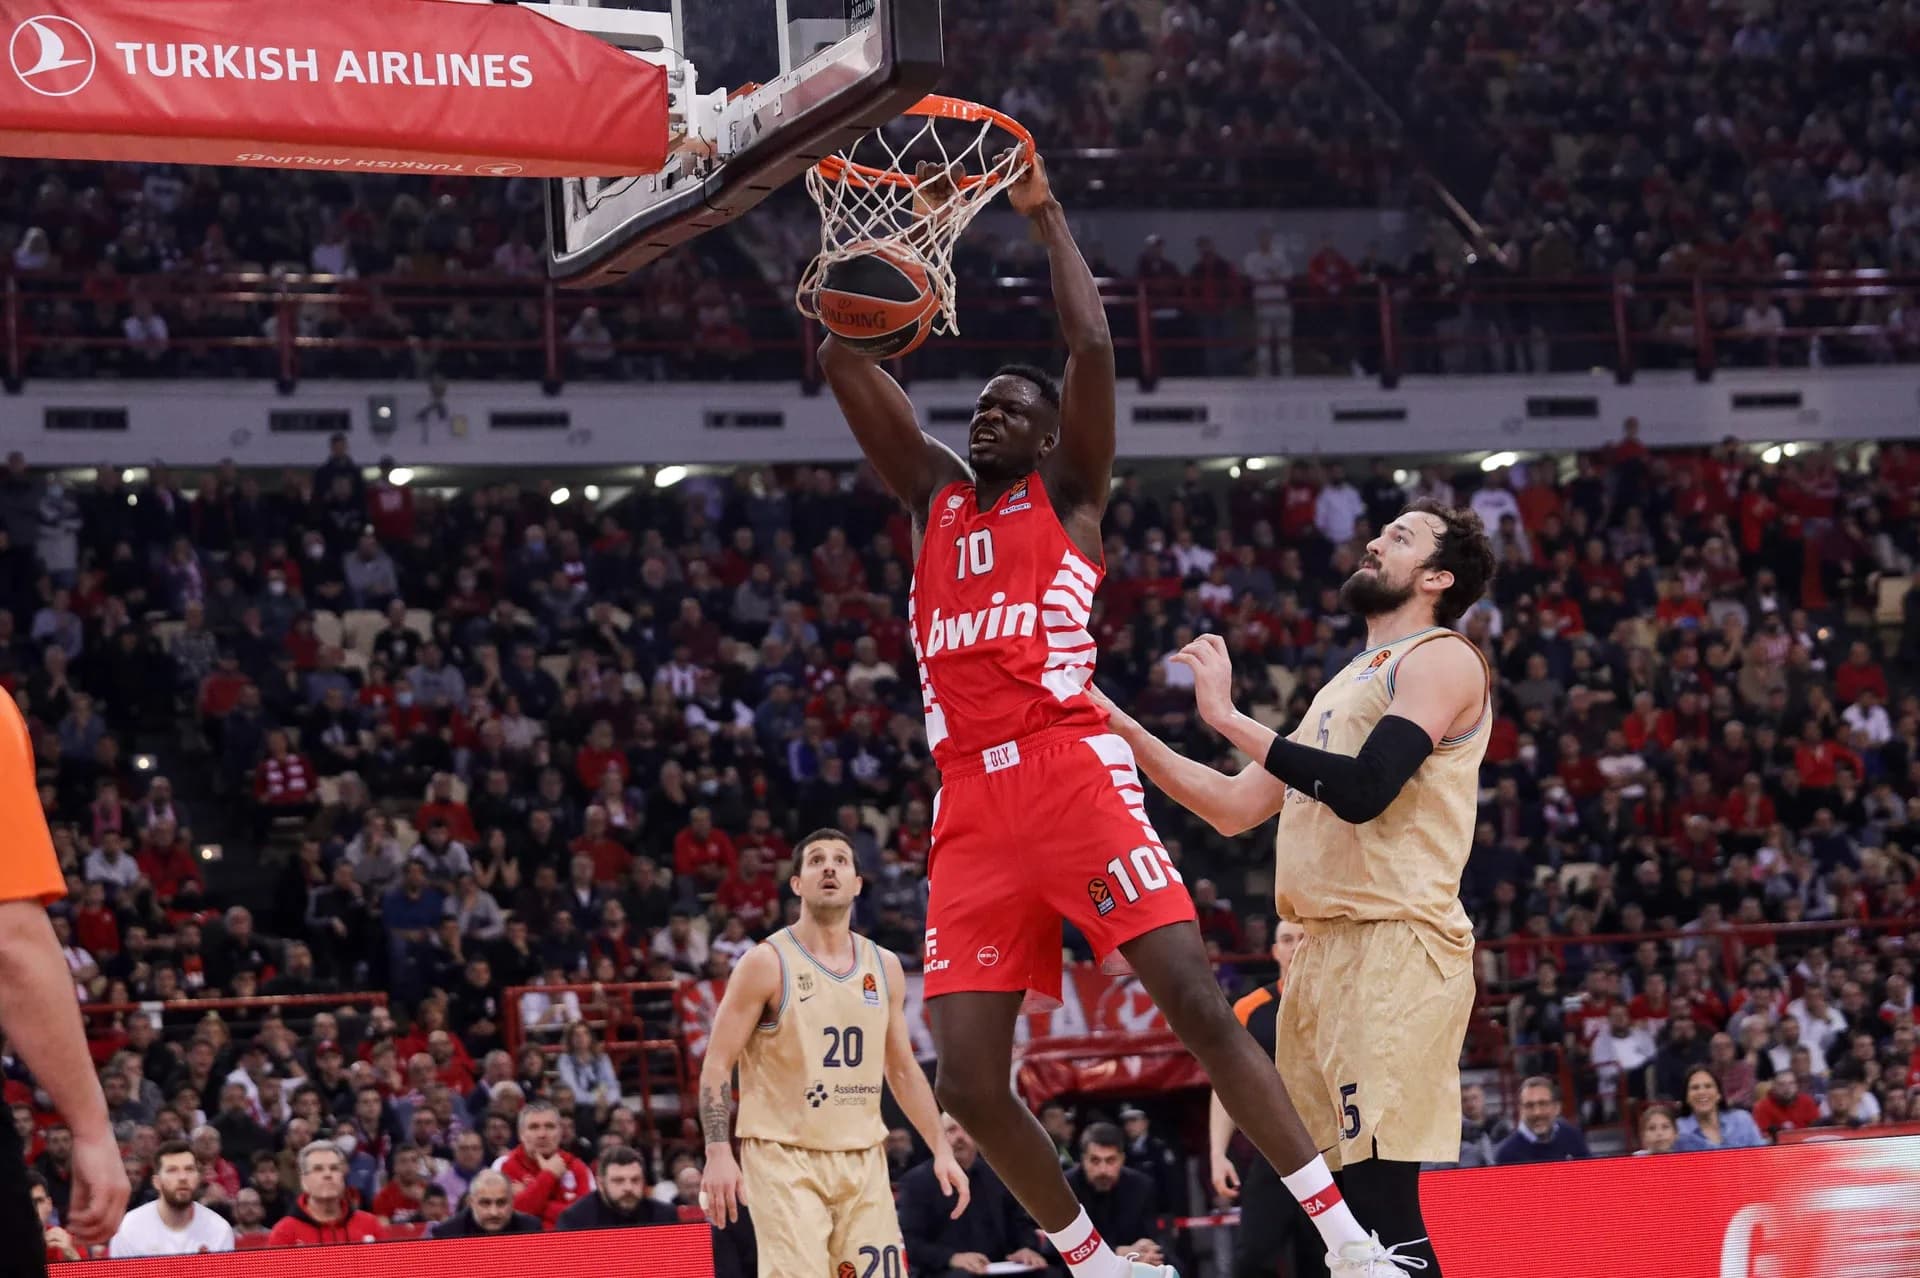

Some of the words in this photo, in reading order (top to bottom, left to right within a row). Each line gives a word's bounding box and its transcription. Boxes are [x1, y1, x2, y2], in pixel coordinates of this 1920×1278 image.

[115, 42, 318, 82] TURKISH
[334, 48, 533, 88] AIRLINES
[235, 153, 351, 166] AIRLINES
[355, 160, 464, 172] TURKISH
[954, 527, 994, 581] 10
[926, 592, 1038, 658] bwin
[990, 746, 1010, 768] OLY
[1106, 845, 1168, 904] 10
[823, 1026, 864, 1068] 20
[1340, 1082, 1361, 1139] 5
[859, 1245, 901, 1278] 20
[1070, 1238, 1098, 1262] GSA
